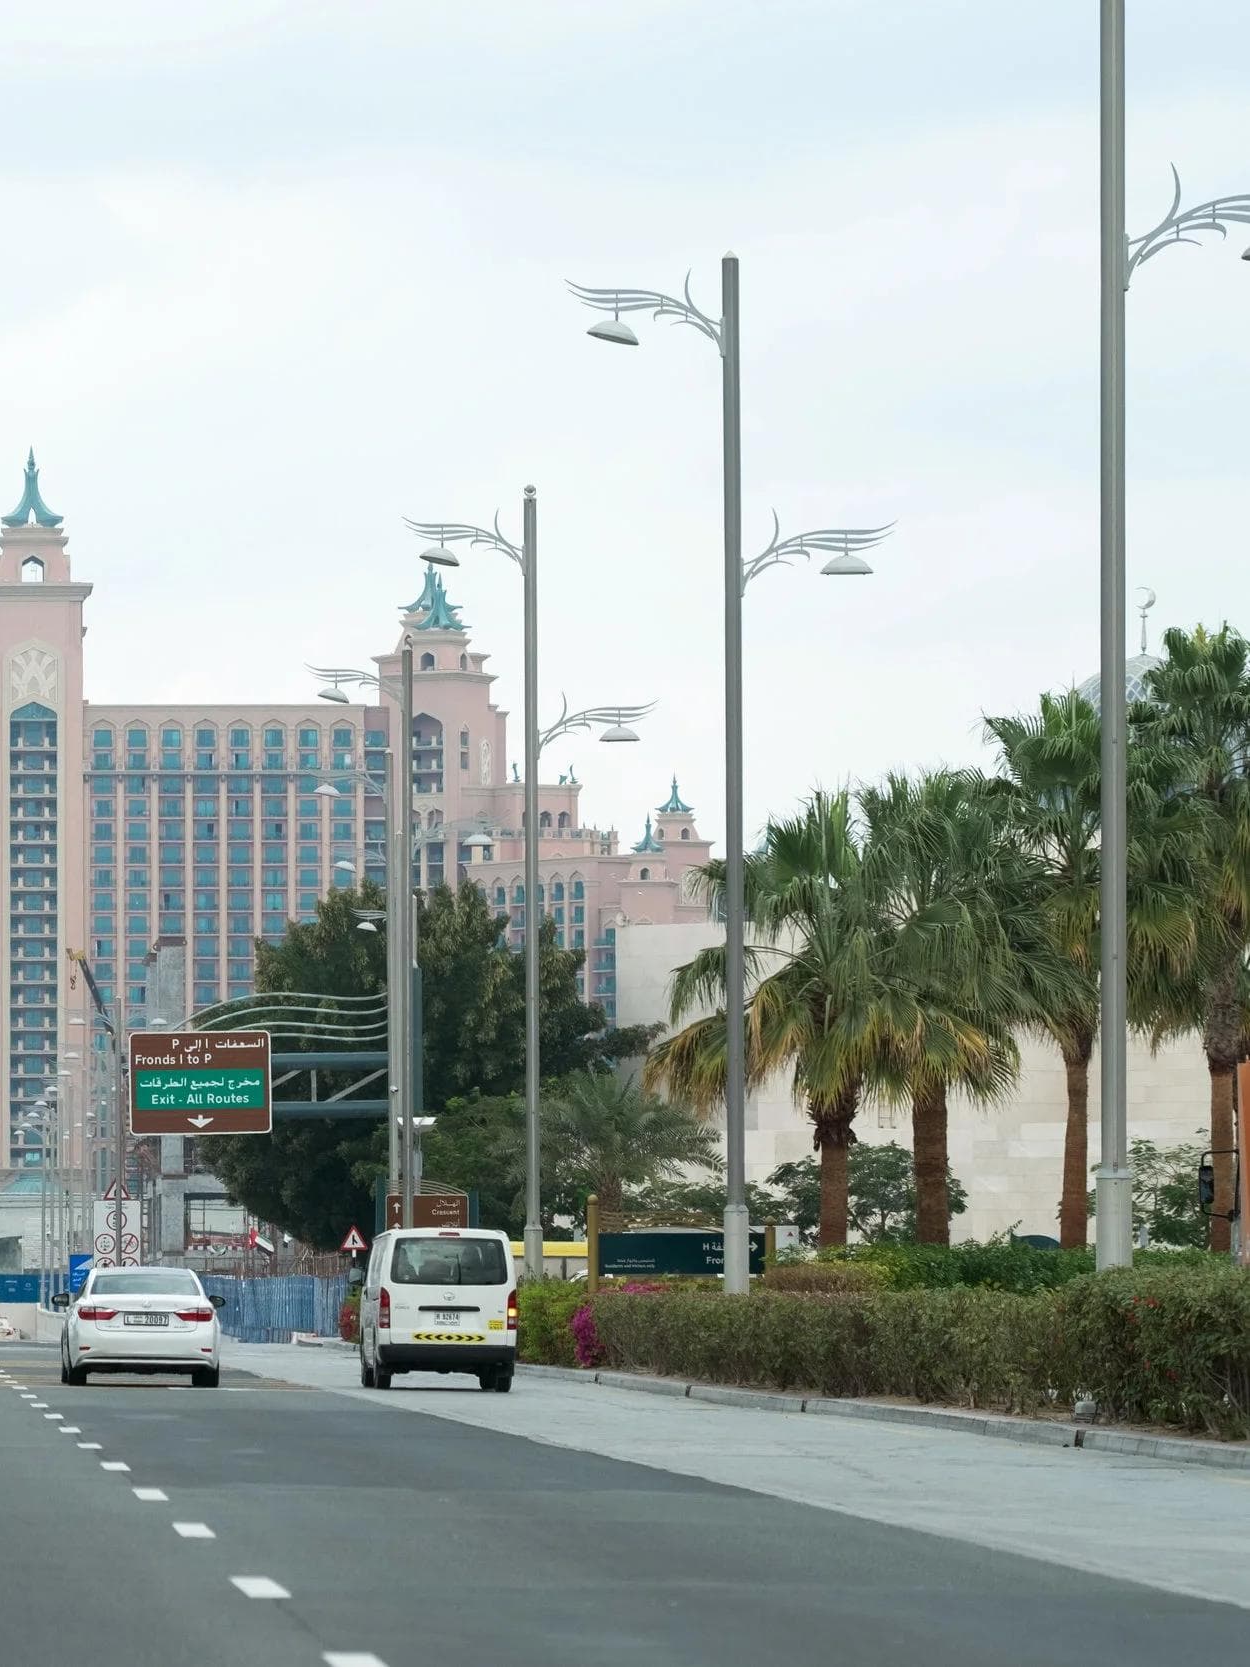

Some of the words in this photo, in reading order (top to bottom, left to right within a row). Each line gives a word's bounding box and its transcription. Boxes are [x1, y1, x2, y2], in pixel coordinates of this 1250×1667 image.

[172, 1038, 180, 1049] P
[184, 1039, 202, 1052] إلى
[215, 1038, 265, 1049] السعفات
[135, 1054, 176, 1065] Fronds
[187, 1054, 200, 1064] to
[204, 1053, 212, 1064] P
[139, 1077, 187, 1090] الطرقات
[190, 1077, 225, 1090] لجميع
[228, 1077, 260, 1089] مخرج
[151, 1094, 175, 1104] Exit
[186, 1094, 203, 1104] All
[207, 1094, 249, 1104] Routes
[432, 1208, 460, 1216] Crescent
[702, 1242, 710, 1250] H
[706, 1256, 725, 1265] Fro
